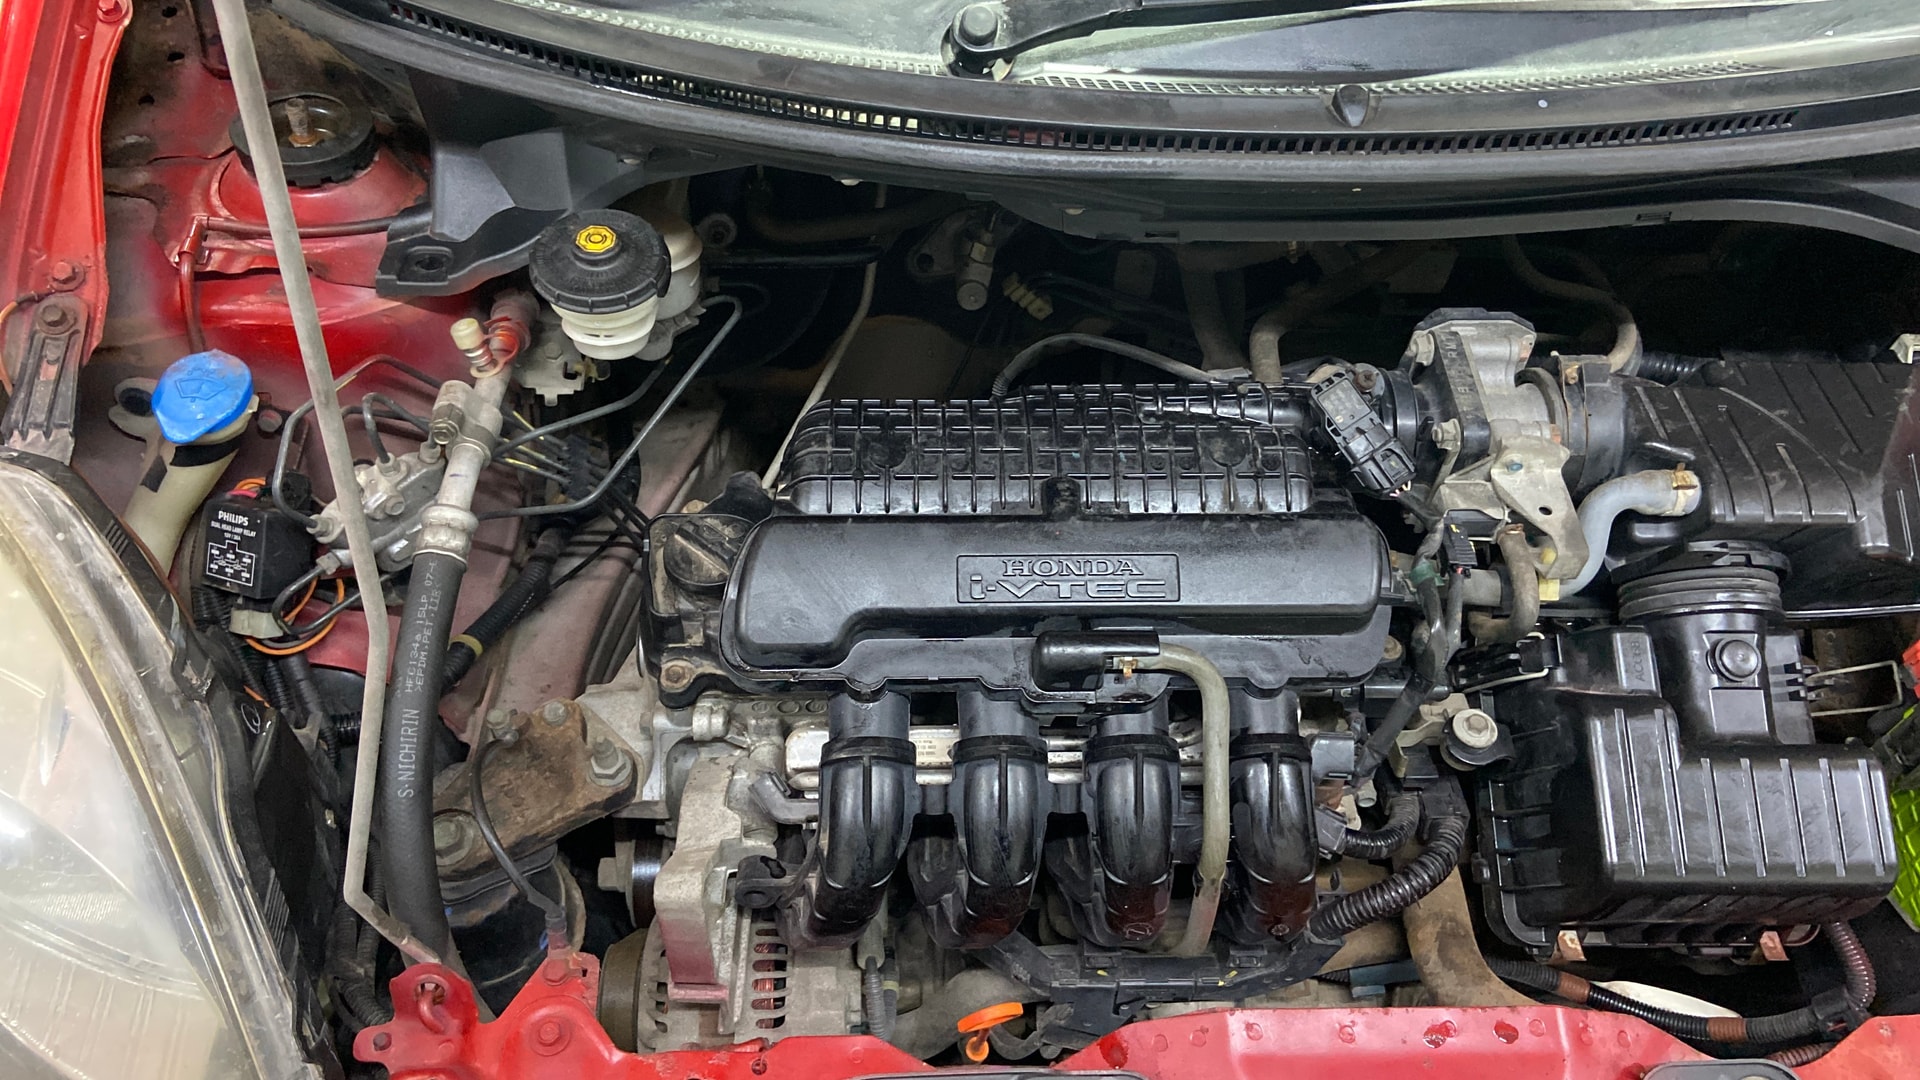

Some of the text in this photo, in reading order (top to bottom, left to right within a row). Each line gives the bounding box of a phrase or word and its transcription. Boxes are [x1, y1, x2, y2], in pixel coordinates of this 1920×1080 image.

[218, 510, 249, 526] PHILIPS
[1002, 558, 1143, 577] HONDA
[969, 574, 1167, 600] i-VTEC
[404, 633, 421, 693] HFC134a
